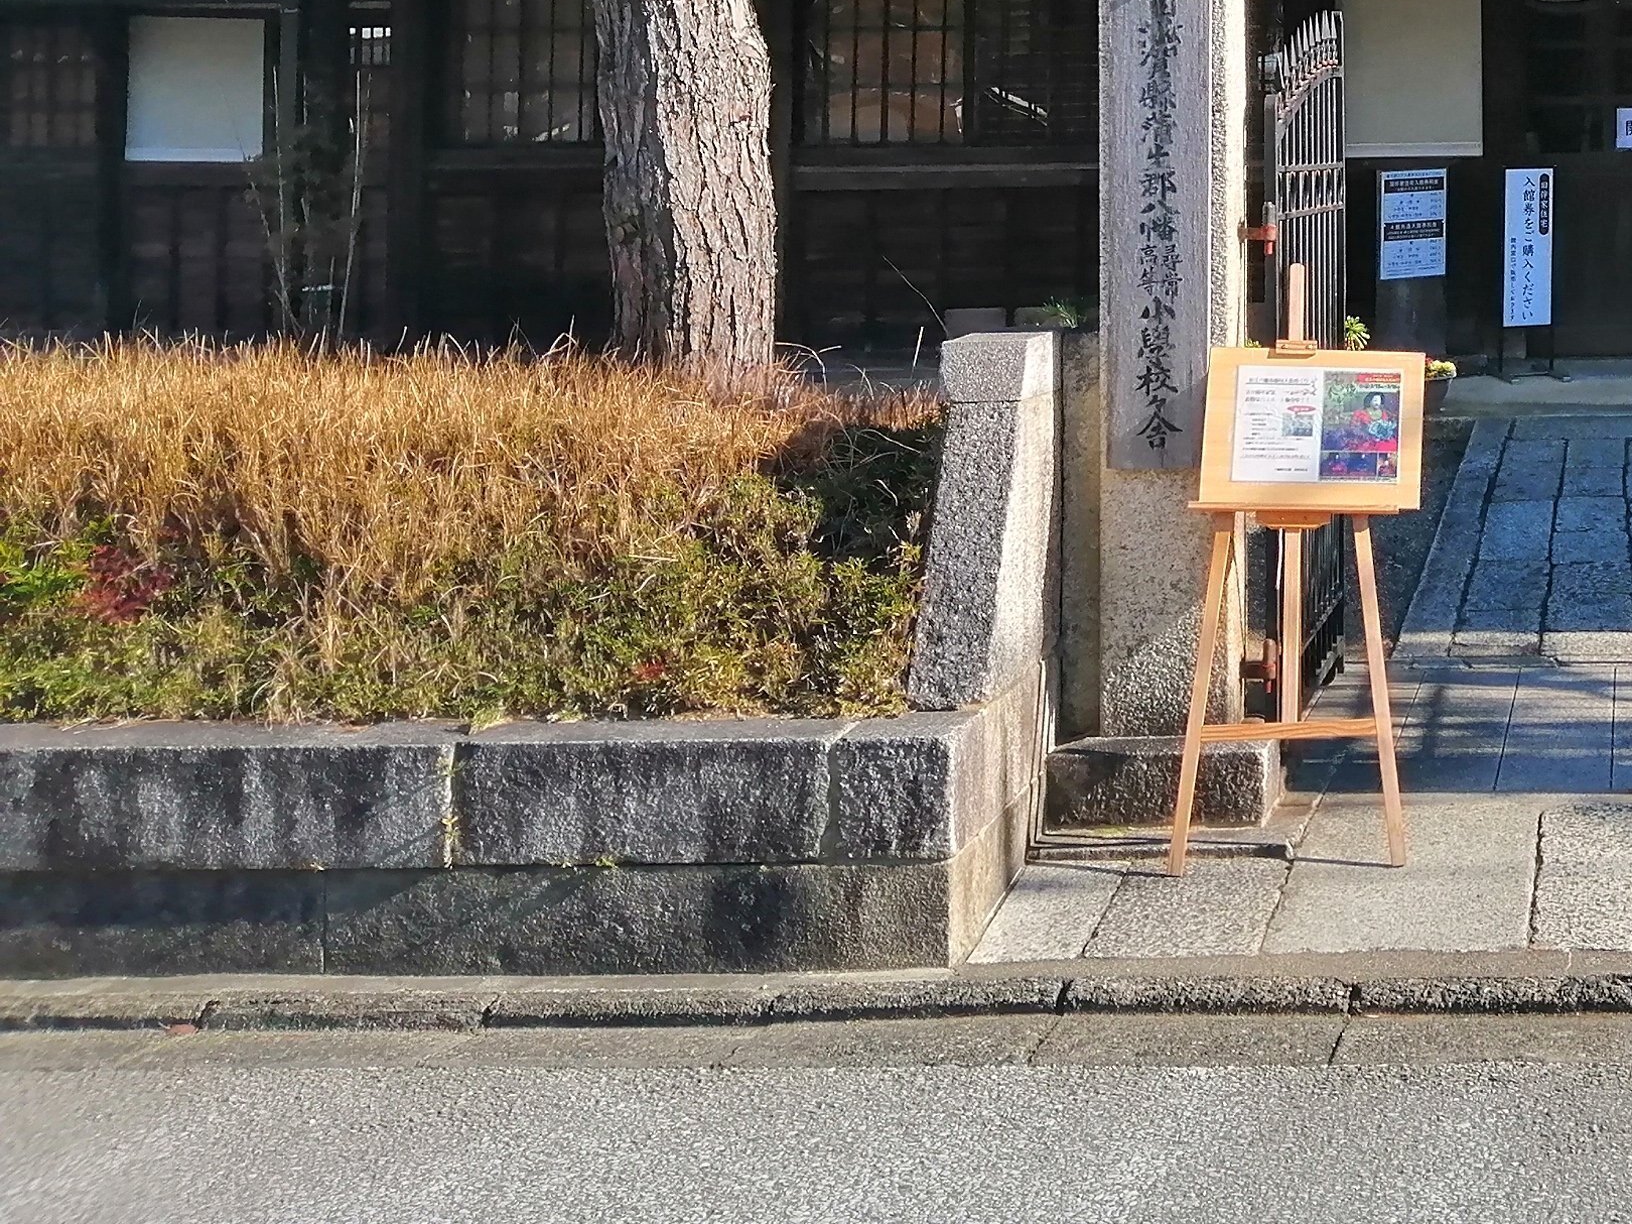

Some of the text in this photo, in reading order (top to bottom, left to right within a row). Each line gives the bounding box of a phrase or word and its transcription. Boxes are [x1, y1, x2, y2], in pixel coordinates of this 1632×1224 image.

[1522, 176, 1536, 321] 入館券をご購入ください
